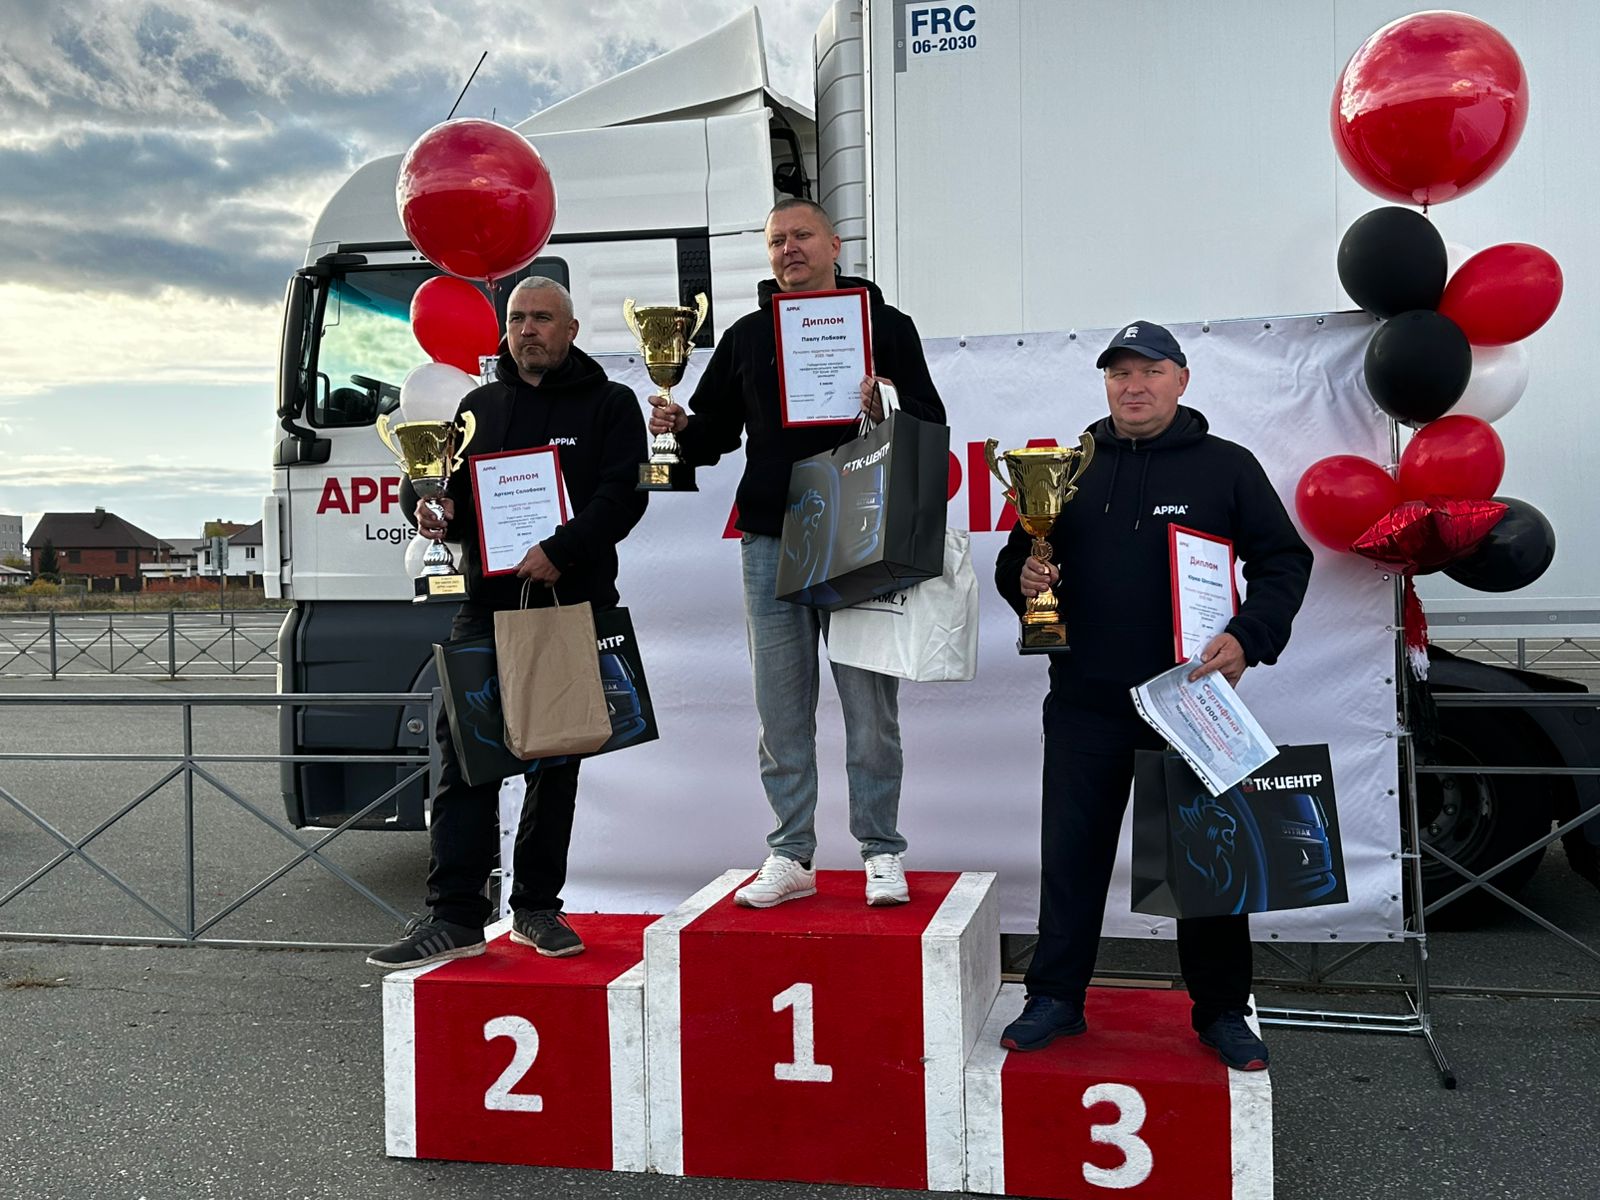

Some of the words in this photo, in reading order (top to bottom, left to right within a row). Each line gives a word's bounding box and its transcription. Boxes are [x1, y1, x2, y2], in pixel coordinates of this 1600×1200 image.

[911, 5, 976, 36] FRC
[912, 35, 977, 54] 06-2030
[802, 316, 845, 328] Диплом
[498, 472, 539, 485] Диплом
[316, 477, 401, 514] APP
[366, 524, 417, 544] Logis
[1190, 556, 1218, 571] Диплом
[597, 634, 625, 651] НТР
[1195, 693, 1207, 706] 30
[1204, 706, 1218, 722] 000
[1202, 683, 1244, 736] Сертификат
[771, 982, 834, 1083] 1
[483, 1016, 544, 1113] 2
[1081, 1082, 1154, 1189] 3
